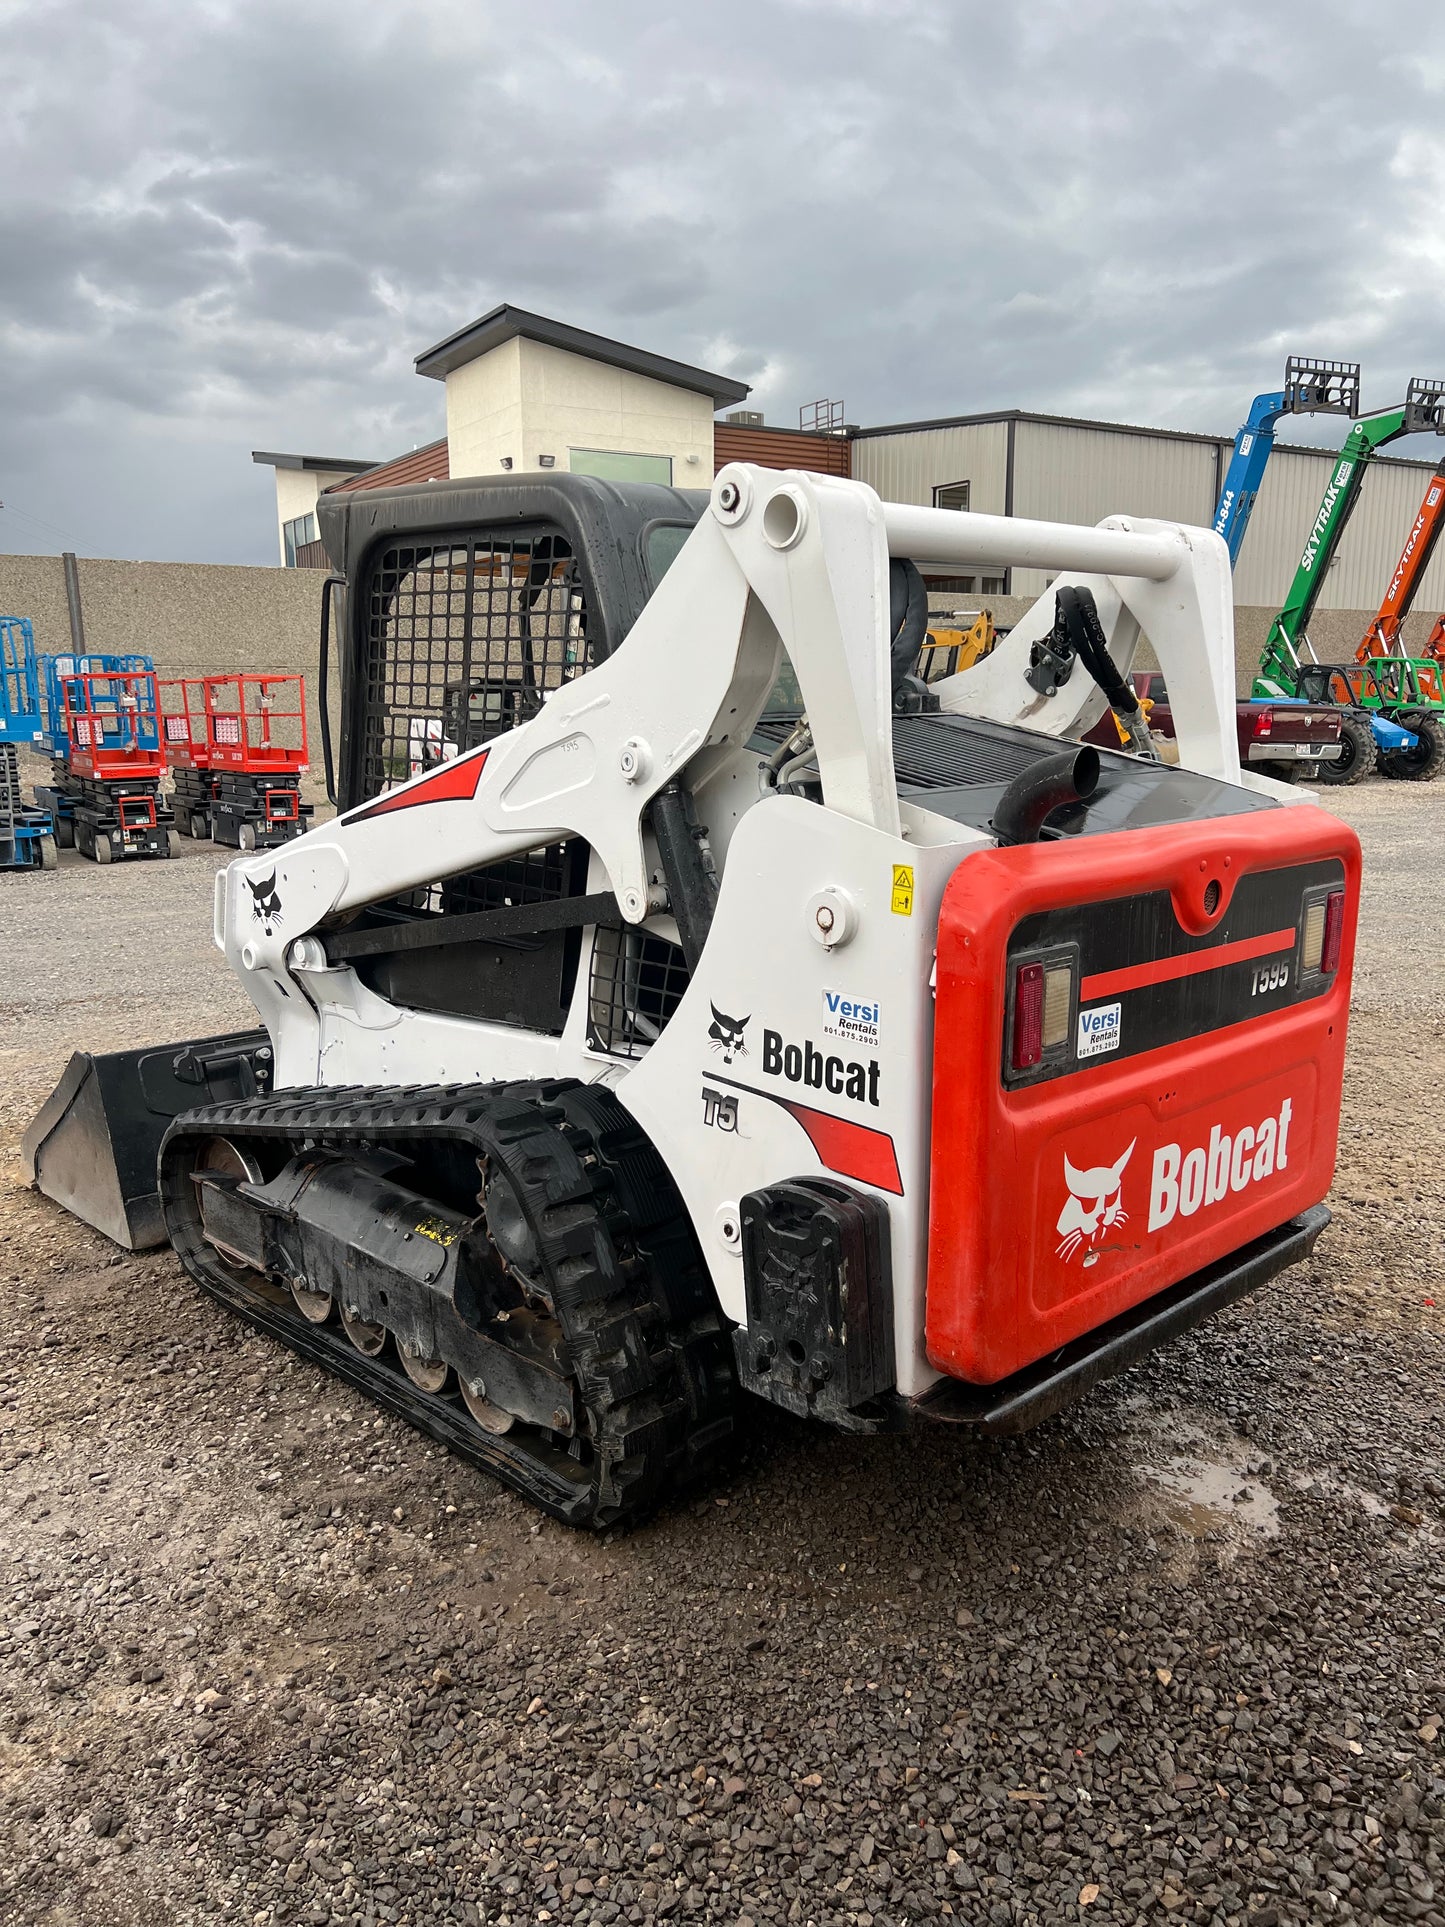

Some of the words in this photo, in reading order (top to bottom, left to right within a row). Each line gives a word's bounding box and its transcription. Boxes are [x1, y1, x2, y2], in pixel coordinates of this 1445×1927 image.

[1241, 436, 1249, 453] Versi
[1336, 462, 1348, 484] Versi
[1301, 482, 1340, 572] SKYTRAK
[1388, 513, 1425, 602] SKYTRAK
[1251, 960, 1290, 997] T595
[825, 992, 879, 1023] Versi
[1081, 1006, 1120, 1033] Versi
[824, 1026, 879, 1046] 801.875.2903
[838, 1017, 878, 1036] Rentals
[1090, 1028, 1118, 1044] Rentals
[1078, 1039, 1118, 1057] 801.875.2903
[763, 1028, 881, 1107] Bobcat
[1147, 1097, 1293, 1234] Bobcat
